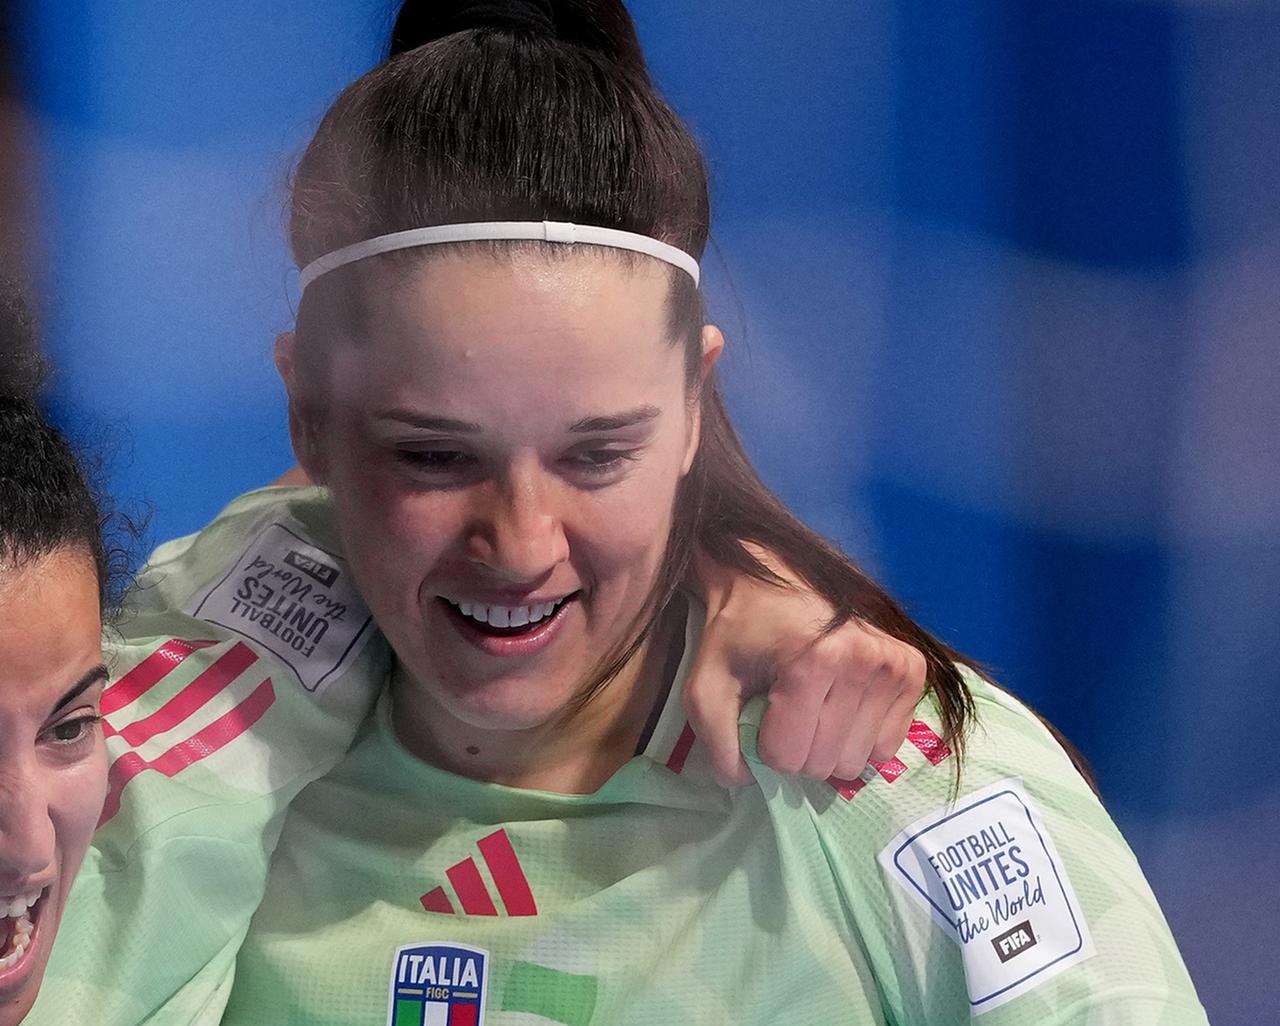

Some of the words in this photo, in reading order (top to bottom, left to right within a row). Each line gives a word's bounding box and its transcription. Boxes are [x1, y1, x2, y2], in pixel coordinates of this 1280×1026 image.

[243, 555, 313, 601] World
[229, 597, 317, 659] FOOTBALL
[236, 576, 330, 645] UNITES
[927, 821, 1016, 879] FOOTBALL
[942, 845, 1031, 912] UNITES
[954, 911, 990, 945] the
[984, 875, 1047, 927] World
[397, 954, 480, 988] ITALIA
[998, 929, 1032, 956] FIFA
[425, 986, 451, 1000] FIGC
